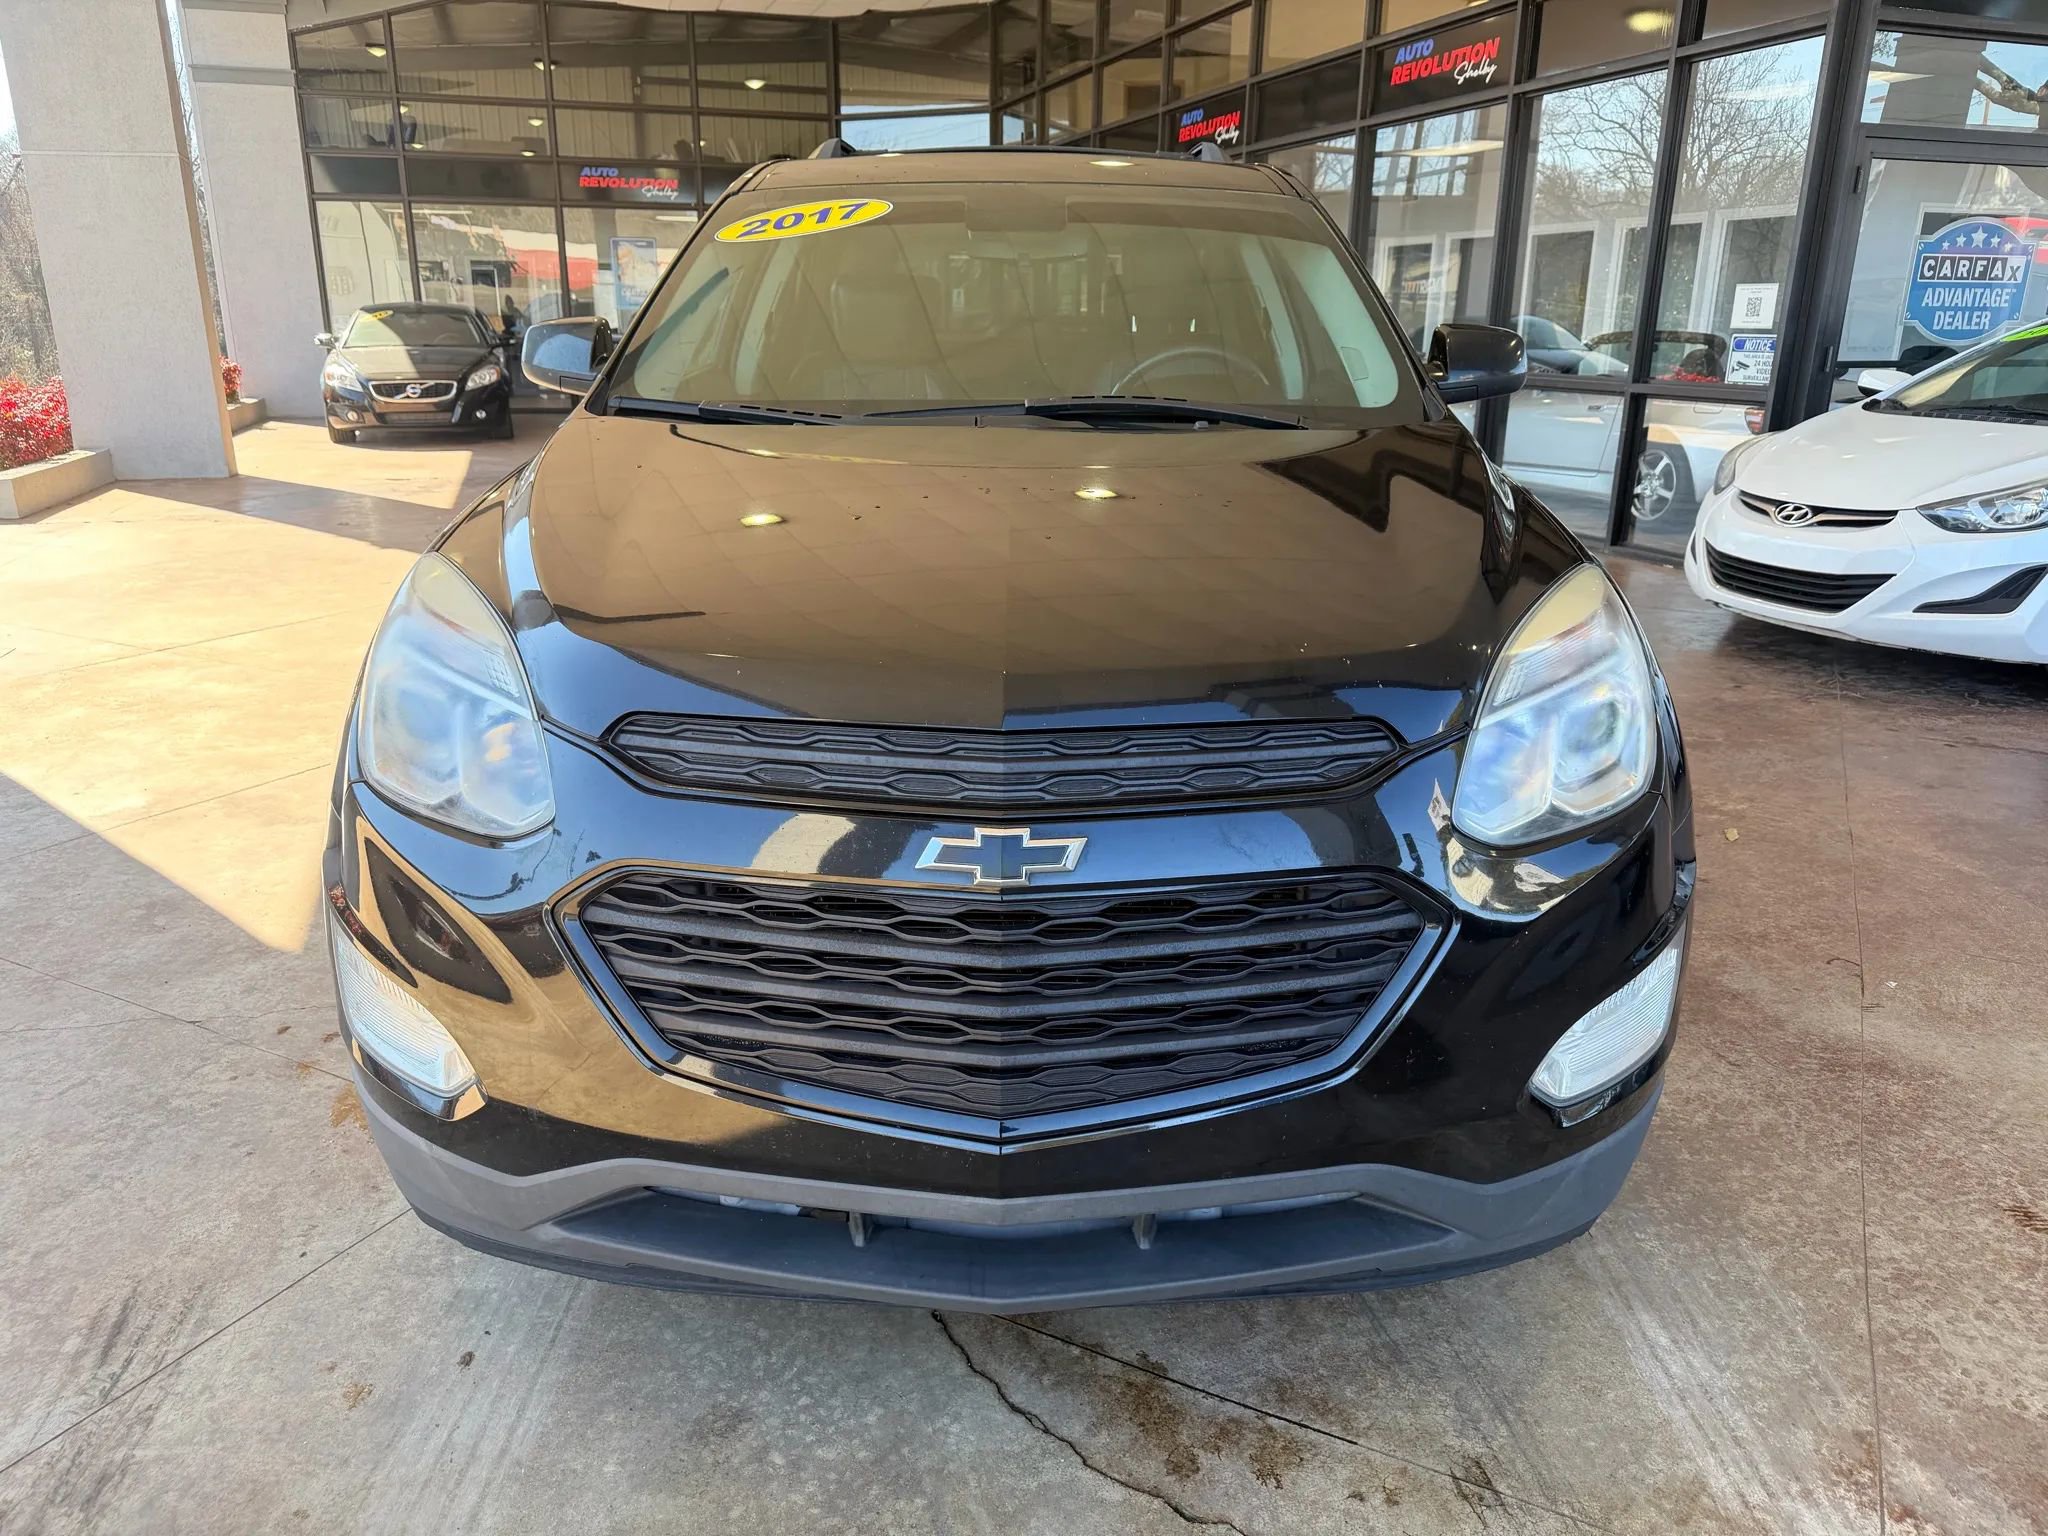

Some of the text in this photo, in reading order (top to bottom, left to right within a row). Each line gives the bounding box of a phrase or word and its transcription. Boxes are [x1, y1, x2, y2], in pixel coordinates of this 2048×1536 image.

[1391, 37, 1500, 86] REVOLUTION
[1394, 38, 1434, 65] AUTO
[1453, 55, 1498, 85] Shelby
[1178, 110, 1241, 143] REVOLUTION
[1181, 108, 1204, 127] AUTO
[581, 167, 619, 177] AUTO
[579, 177, 679, 189] REVOLUTION
[736, 201, 870, 239] 2017
[1922, 258, 2022, 281] CARFAX
[1921, 287, 2012, 307] ADVANTAGE
[1932, 310, 1992, 330] DEALER
[1744, 339, 1773, 351] NOTICE
[1756, 367, 1770, 375] VIDE
